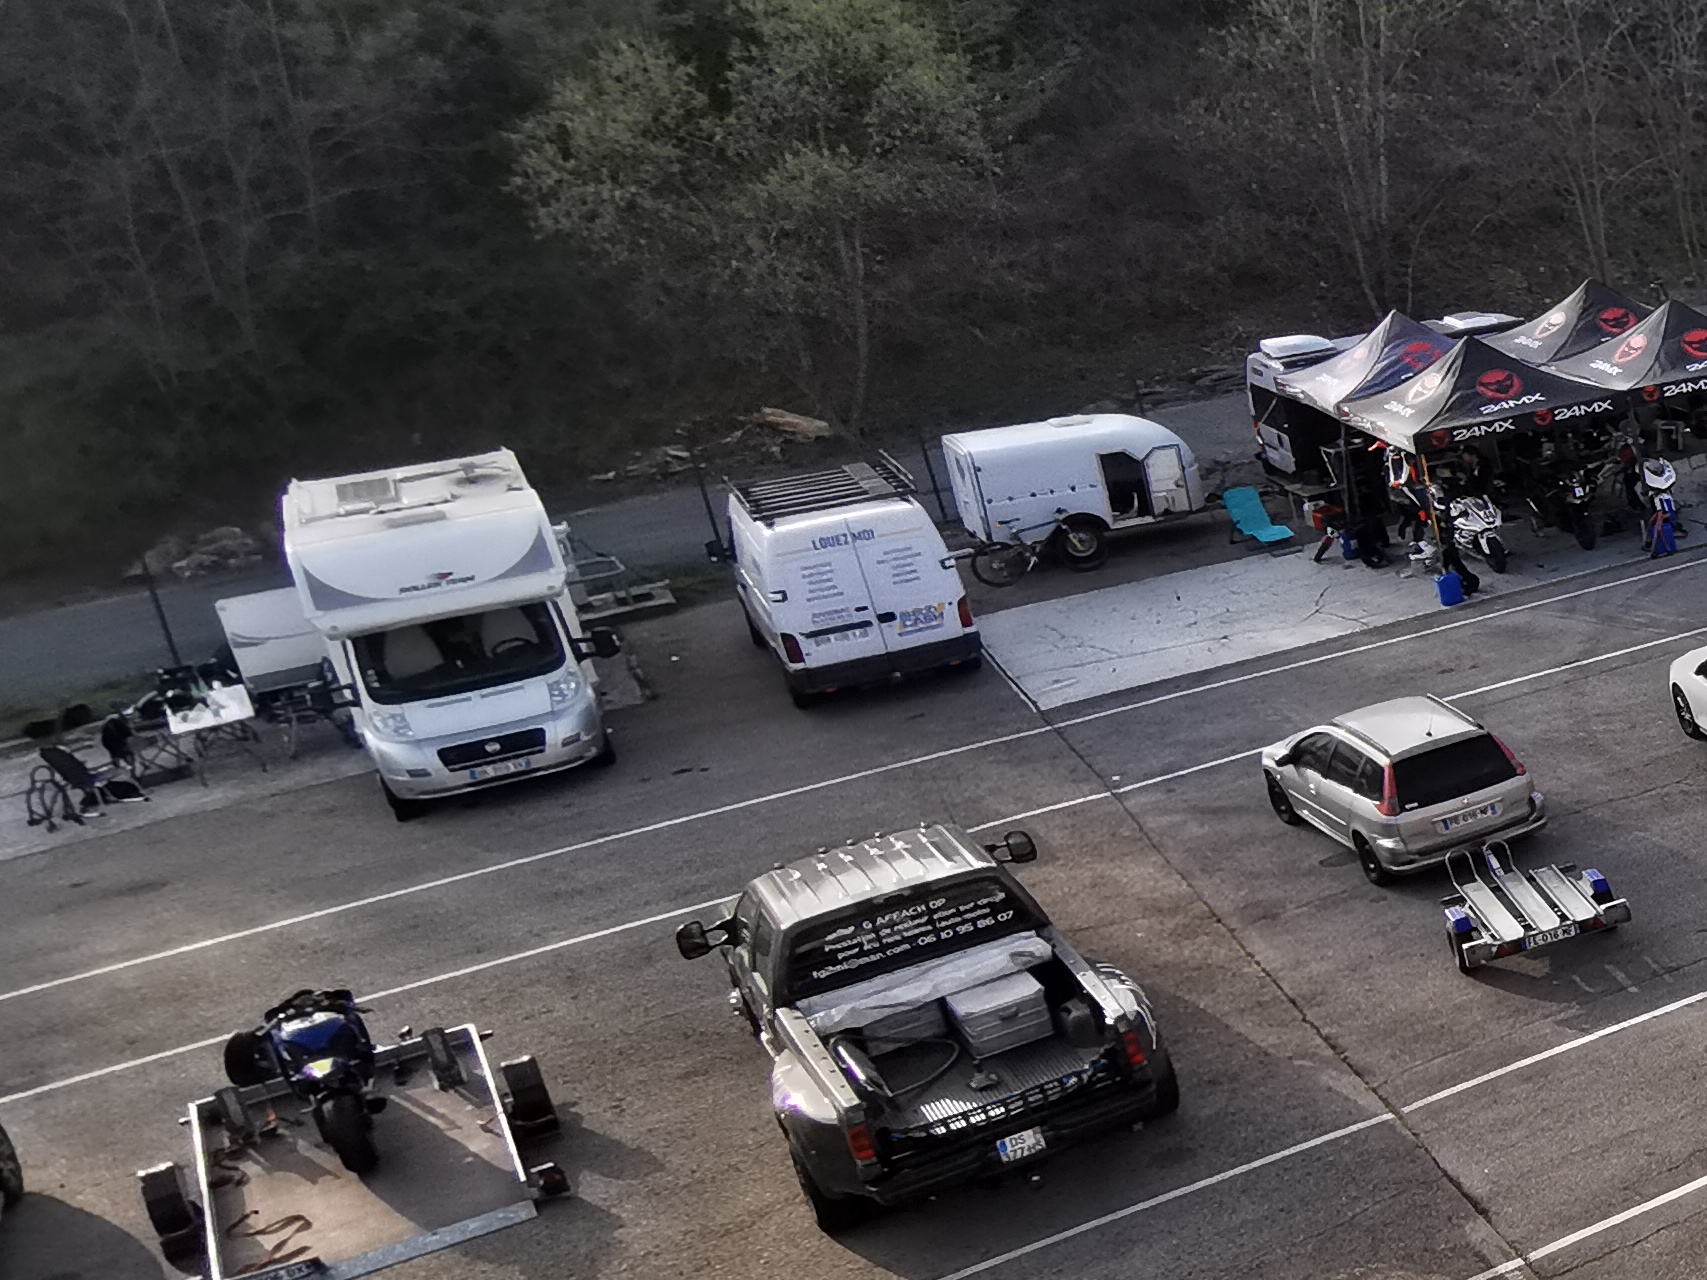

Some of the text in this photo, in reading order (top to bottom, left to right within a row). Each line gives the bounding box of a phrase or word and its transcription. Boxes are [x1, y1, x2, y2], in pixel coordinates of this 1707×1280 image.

[1479, 392, 1545, 415] 24MX
[1554, 400, 1613, 421] 24MX
[1453, 419, 1516, 442] 24MX
[811, 533, 850, 551] LOUEZ
[997, 910, 1014, 922] 07
[1009, 1133, 1027, 1148] DS
